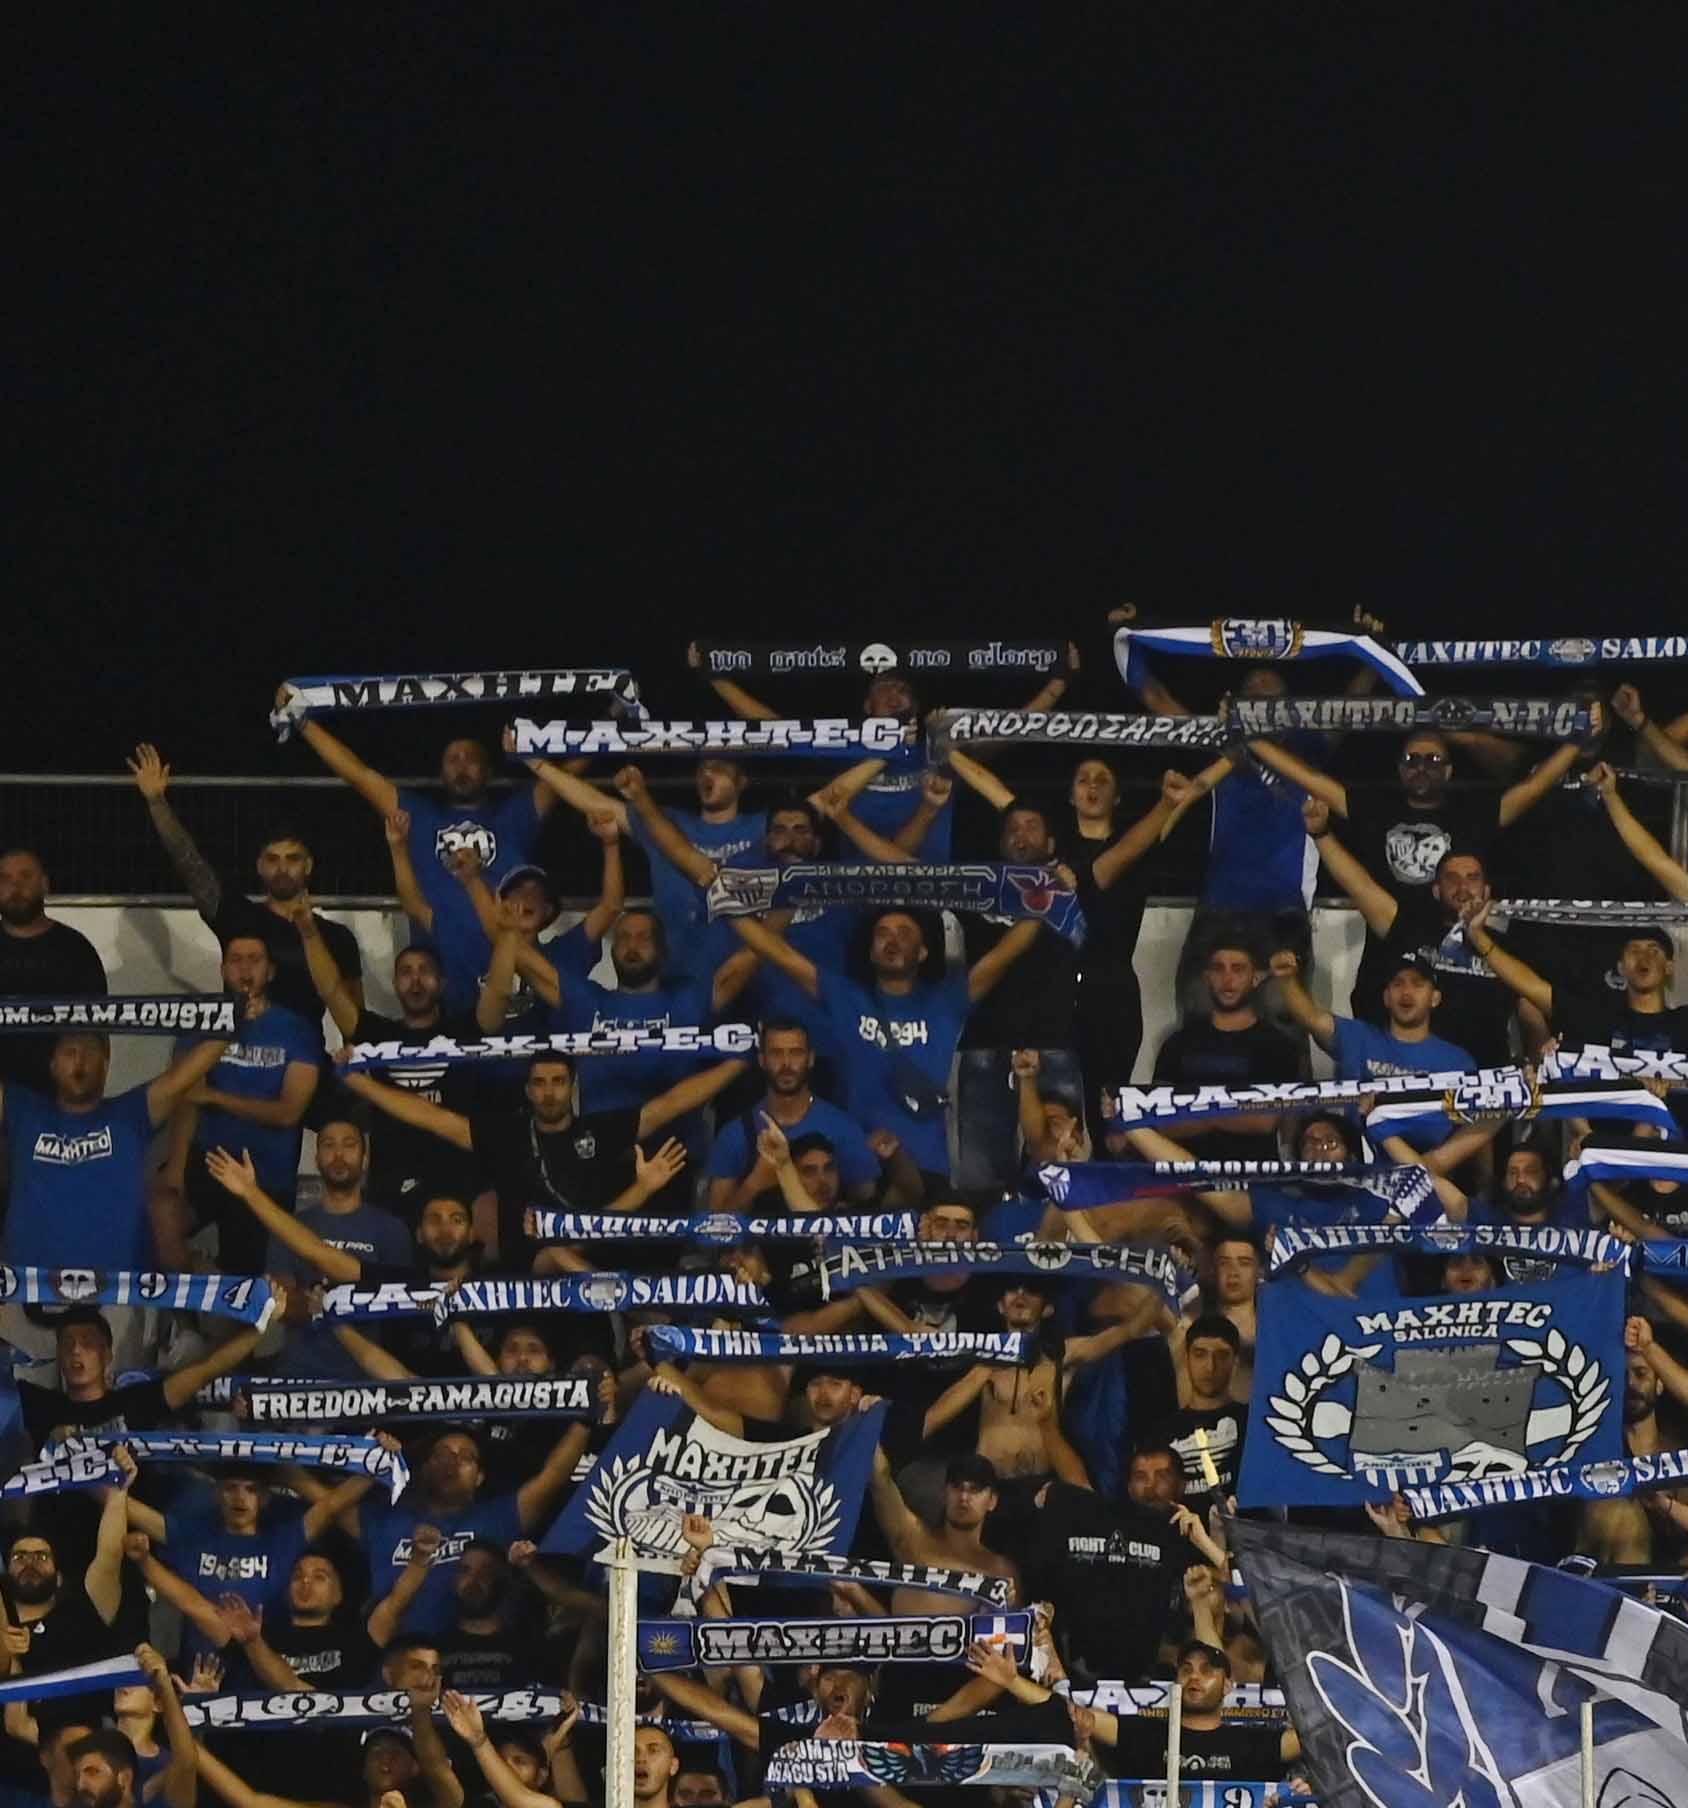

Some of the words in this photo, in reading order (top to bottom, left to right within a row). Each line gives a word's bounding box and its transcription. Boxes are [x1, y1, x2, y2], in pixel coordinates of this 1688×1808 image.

[54, 1001, 235, 1032] FAMAGUSTA
[748, 1214, 918, 1240] SALONICA
[1394, 1325, 1501, 1341] SALONICA
[251, 1389, 389, 1419] FREEDOM
[409, 1379, 591, 1412] FAMAGUSTA
[1068, 1535, 1106, 1555] FIGHT
[1128, 1541, 1161, 1561] CLUB
